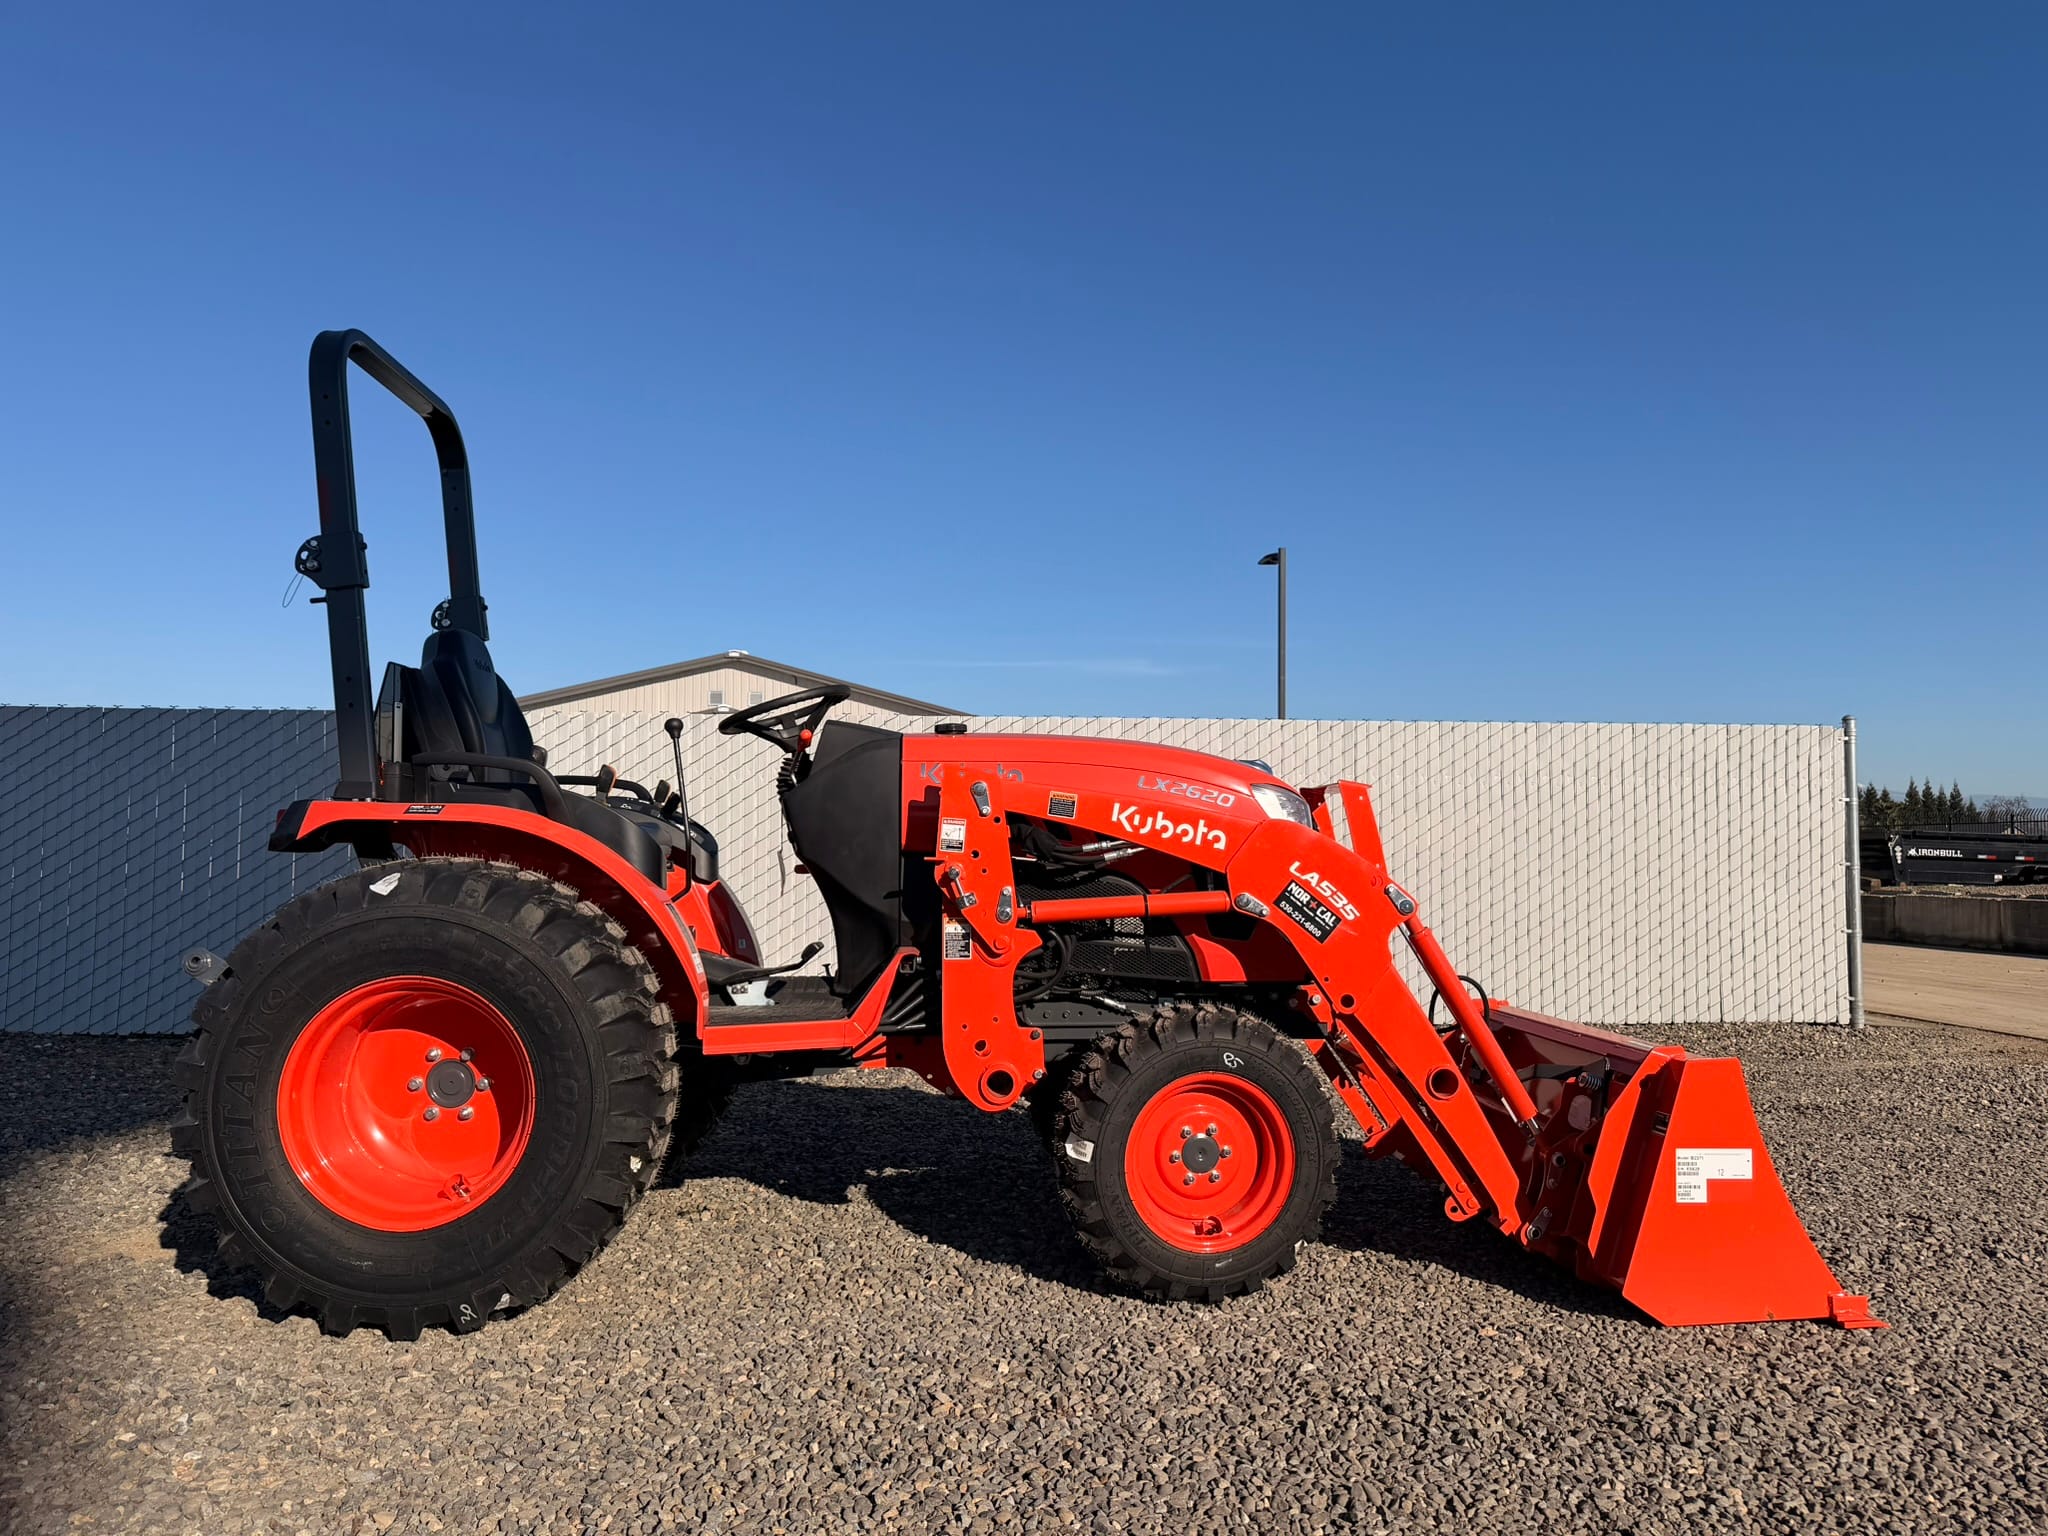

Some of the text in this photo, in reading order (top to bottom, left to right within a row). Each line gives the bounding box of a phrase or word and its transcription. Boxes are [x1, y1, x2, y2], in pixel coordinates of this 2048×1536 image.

[1137, 775, 1235, 807] LX2620
[1111, 802, 1227, 850] Kubota
[1918, 848, 1963, 858] IRONBULL
[1287, 882, 1311, 905] NOR
[1316, 906, 1337, 927] CAL
[1288, 861, 1360, 920] LA535
[219, 1017, 273, 1199] TITAN
